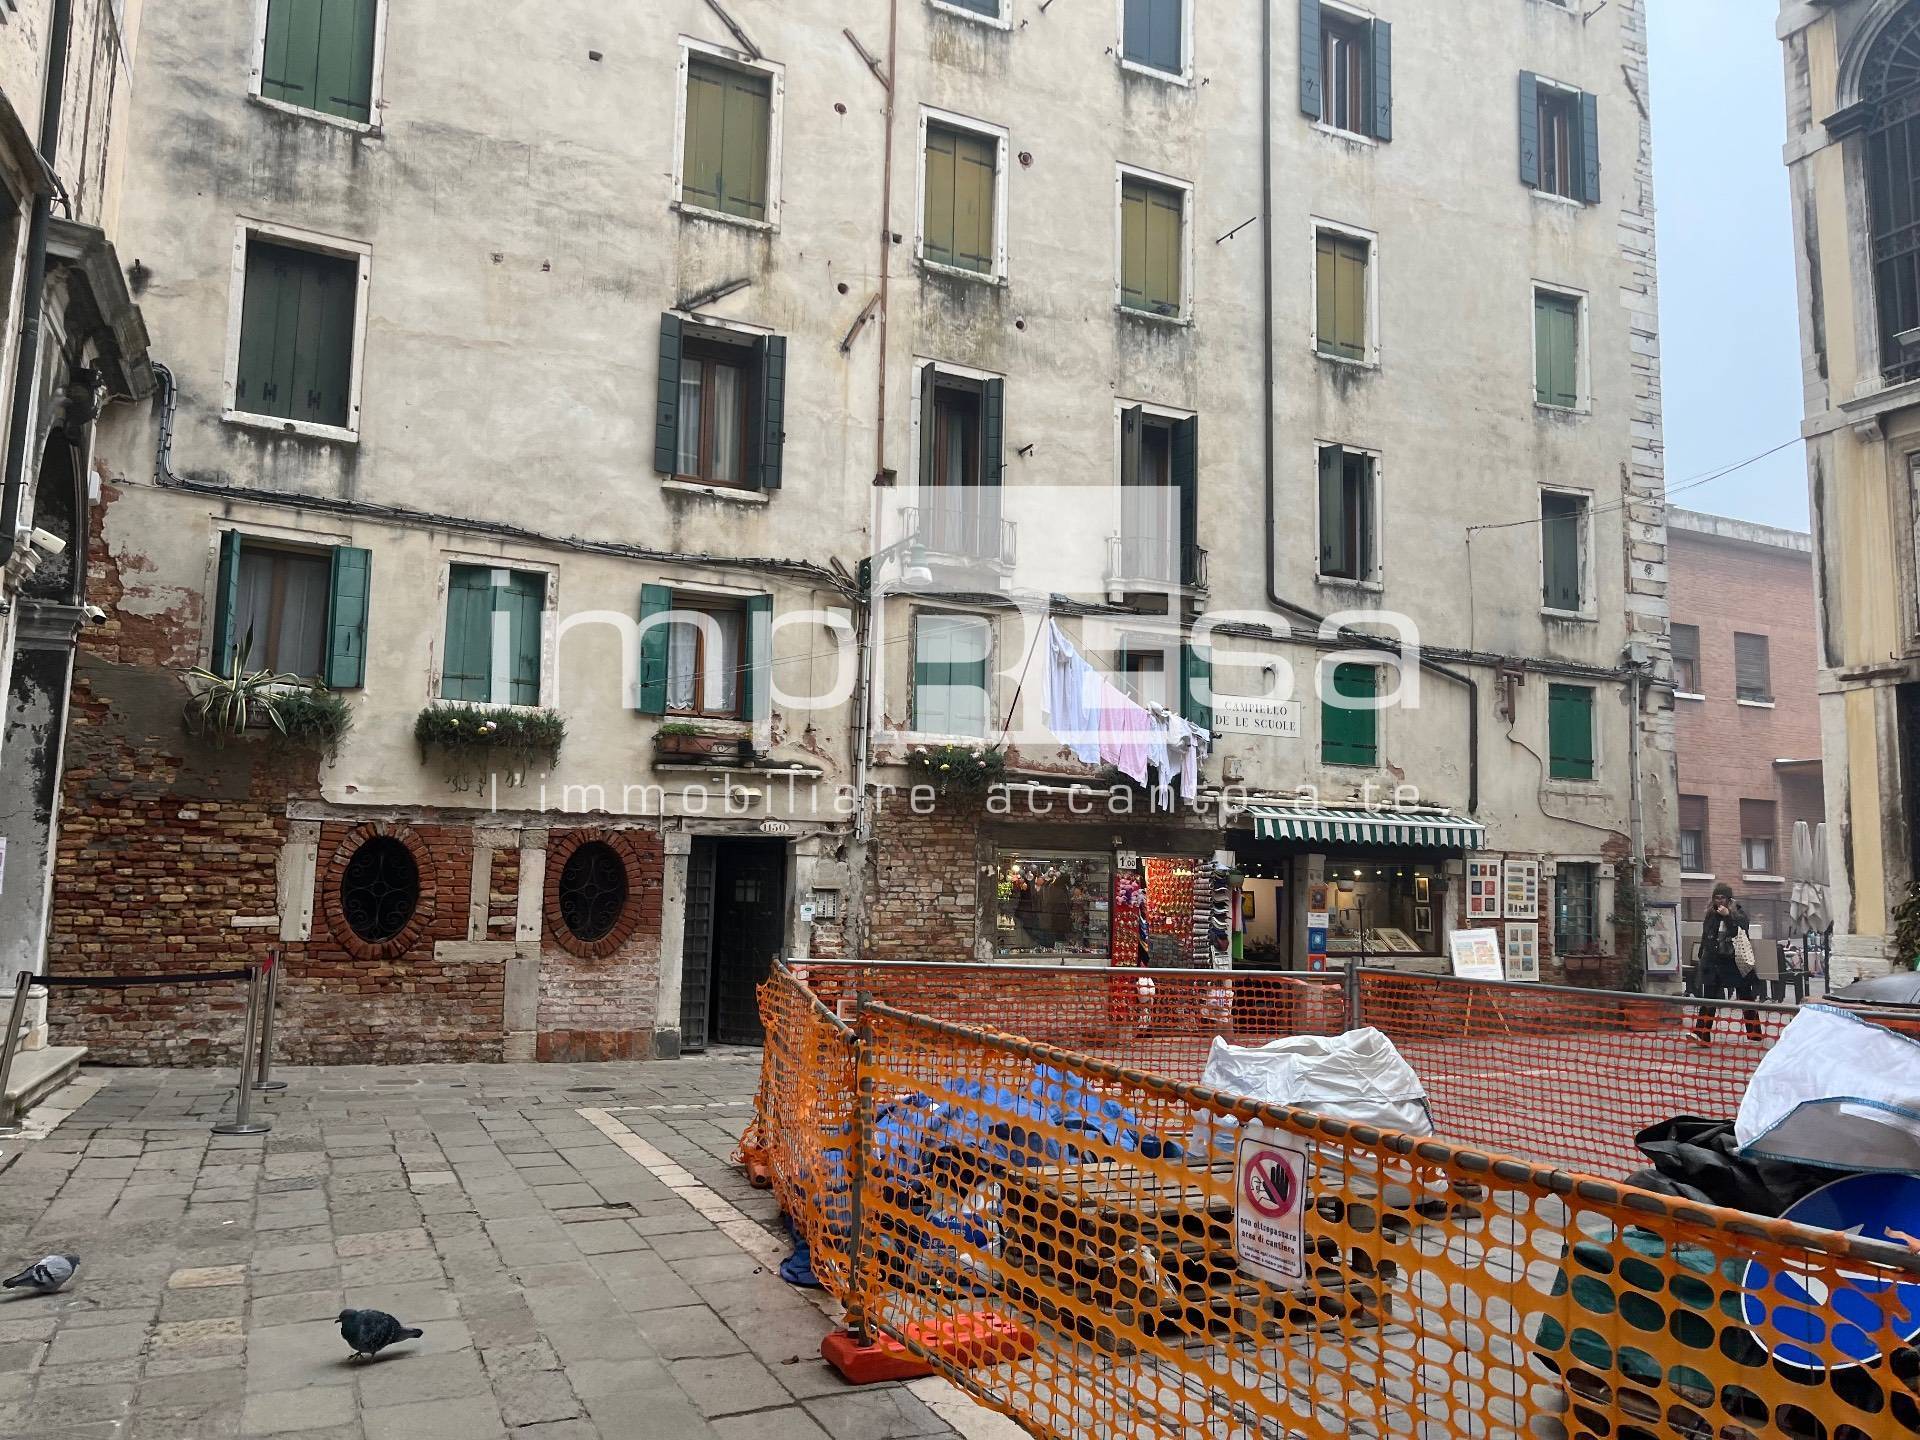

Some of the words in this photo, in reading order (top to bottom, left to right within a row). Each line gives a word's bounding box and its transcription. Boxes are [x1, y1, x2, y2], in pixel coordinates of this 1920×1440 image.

[1224, 701, 1287, 716] CAMPIELLO
[1215, 714, 1229, 726] DE
[1235, 716, 1248, 728] LE
[1254, 718, 1296, 732] SCUOLE
[763, 823, 786, 832] 1150
[1241, 1217, 1251, 1226] non
[1253, 1221, 1296, 1241] oltrepassare
[1241, 1230, 1255, 1240] area
[1257, 1234, 1264, 1244] di
[1265, 1239, 1295, 1254] cantiere
